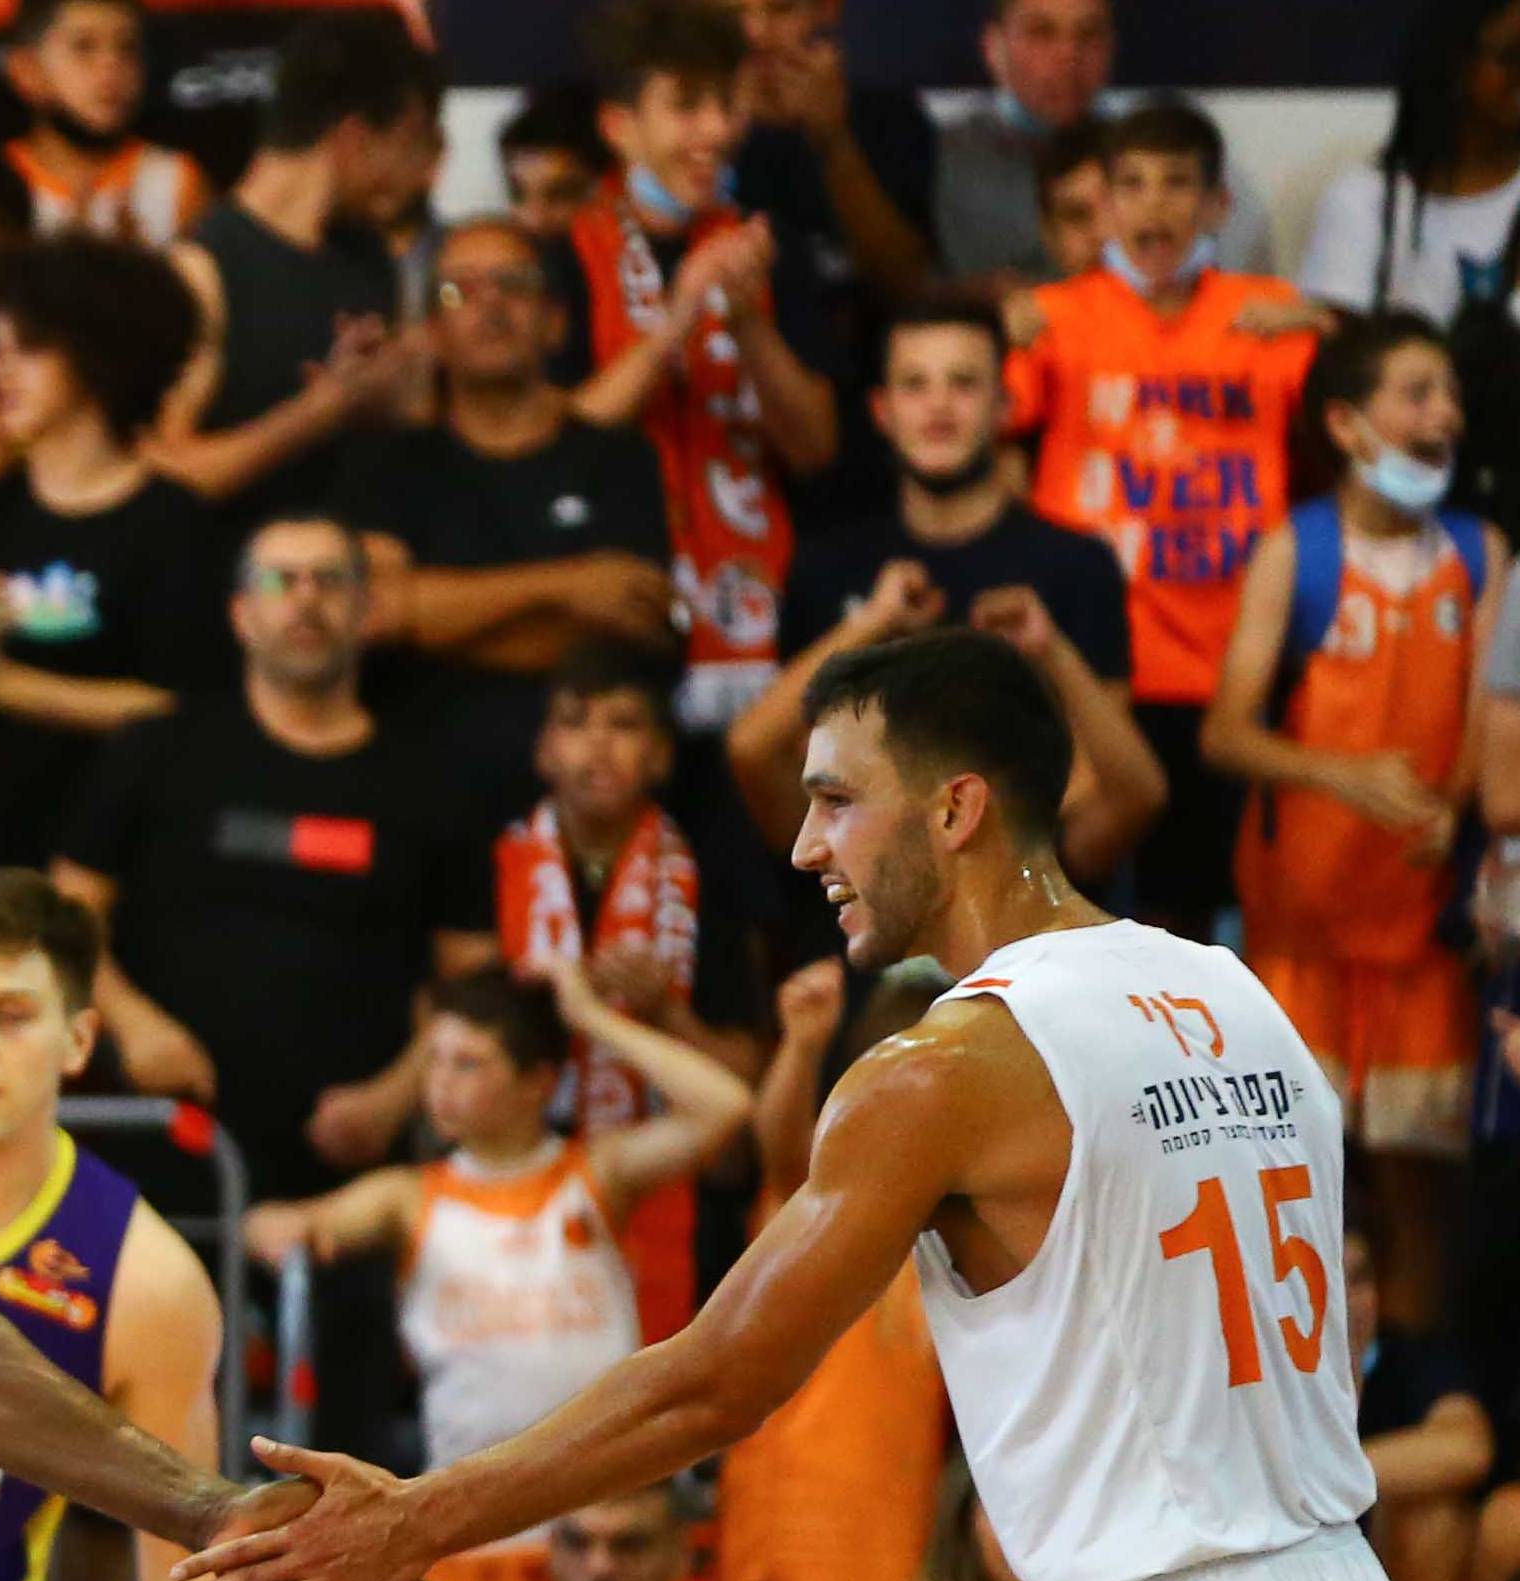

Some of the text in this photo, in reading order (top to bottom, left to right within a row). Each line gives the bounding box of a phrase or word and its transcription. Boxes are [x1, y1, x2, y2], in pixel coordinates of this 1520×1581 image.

[1127, 990, 1225, 1059] לוי
[1143, 1070, 1290, 1130] קפה ציונה
[1157, 1164, 1329, 1388] 15
